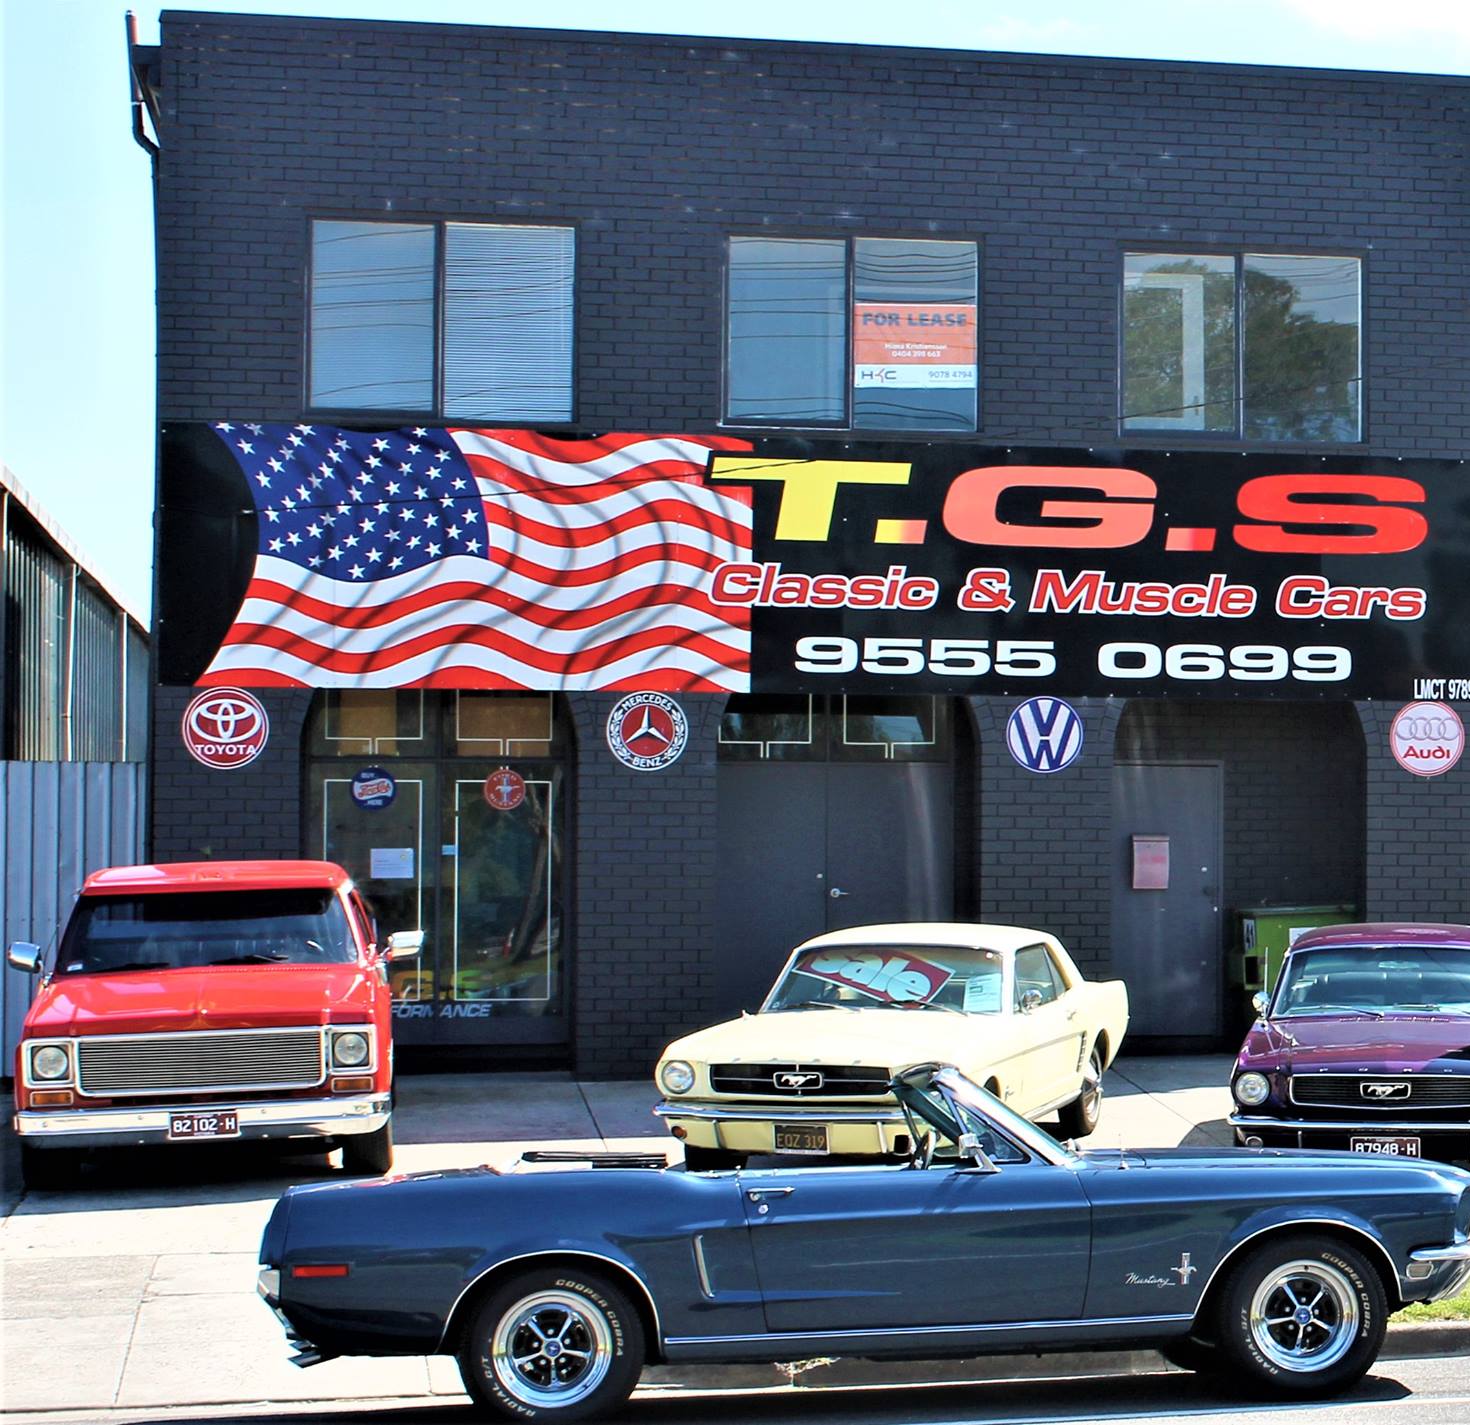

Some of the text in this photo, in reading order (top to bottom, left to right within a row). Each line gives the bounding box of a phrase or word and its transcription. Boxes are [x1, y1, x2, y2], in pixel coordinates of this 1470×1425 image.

[863, 312, 967, 328] FOR LEASE
[711, 457, 1428, 554] T.G.S
[709, 562, 1427, 621] Classic & Muscle Cars
[794, 636, 1352, 682] 9555 0699
[1414, 679, 1446, 700] LMCT
[621, 694, 673, 711] MERCEDES
[195, 744, 257, 755] TOYOTA
[1403, 745, 1451, 759] Audi
[631, 757, 662, 767] BENZ
[390, 1003, 492, 1018] FORMANCE
[804, 1134, 825, 1149] 319
[1124, 1272, 1176, 1289] Mustang
[1320, 1252, 1372, 1338] COOPER COBRA
[554, 1278, 624, 1356] COOPER COBRA
[492, 1385, 537, 1417] RADIAL
